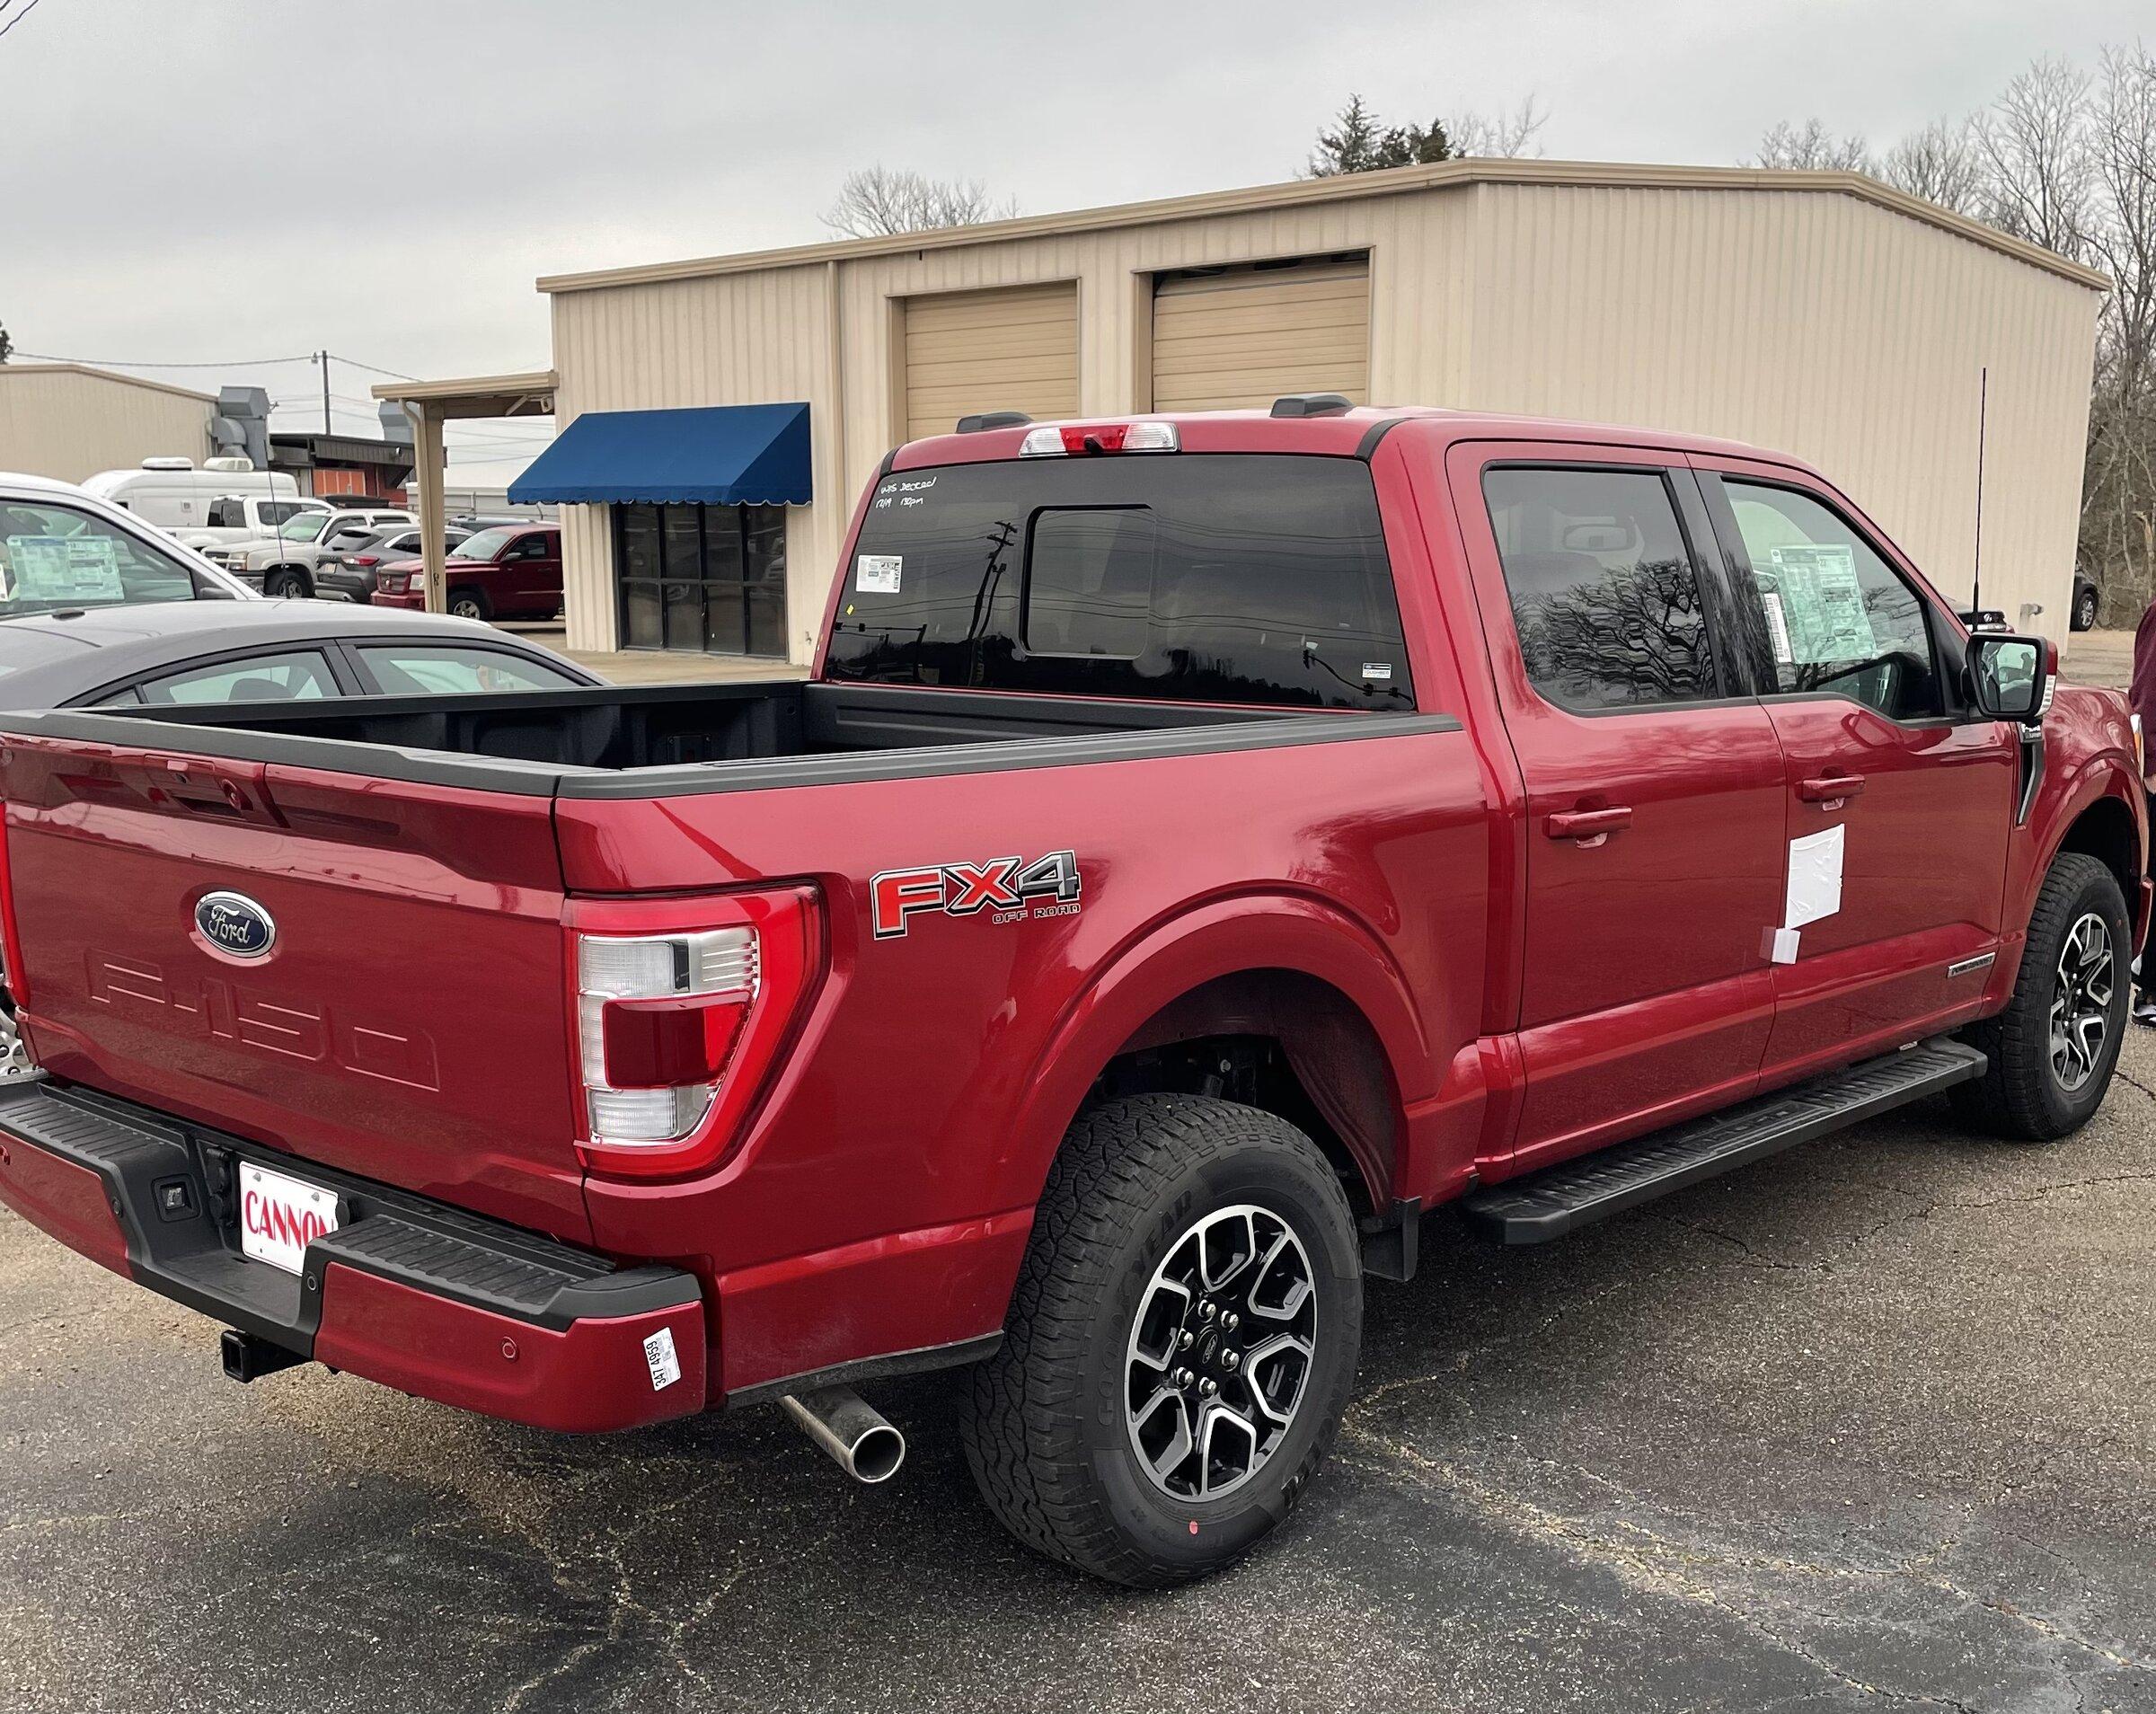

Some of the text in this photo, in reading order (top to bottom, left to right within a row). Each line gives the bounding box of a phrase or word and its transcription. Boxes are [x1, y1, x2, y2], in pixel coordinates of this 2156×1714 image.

[870, 849, 1082, 941] FX4
[992, 904, 1082, 924] OFF ROAD
[208, 905, 251, 944] Ford
[84, 949, 440, 1092] F-150
[646, 1340, 667, 1387] 347 4959
